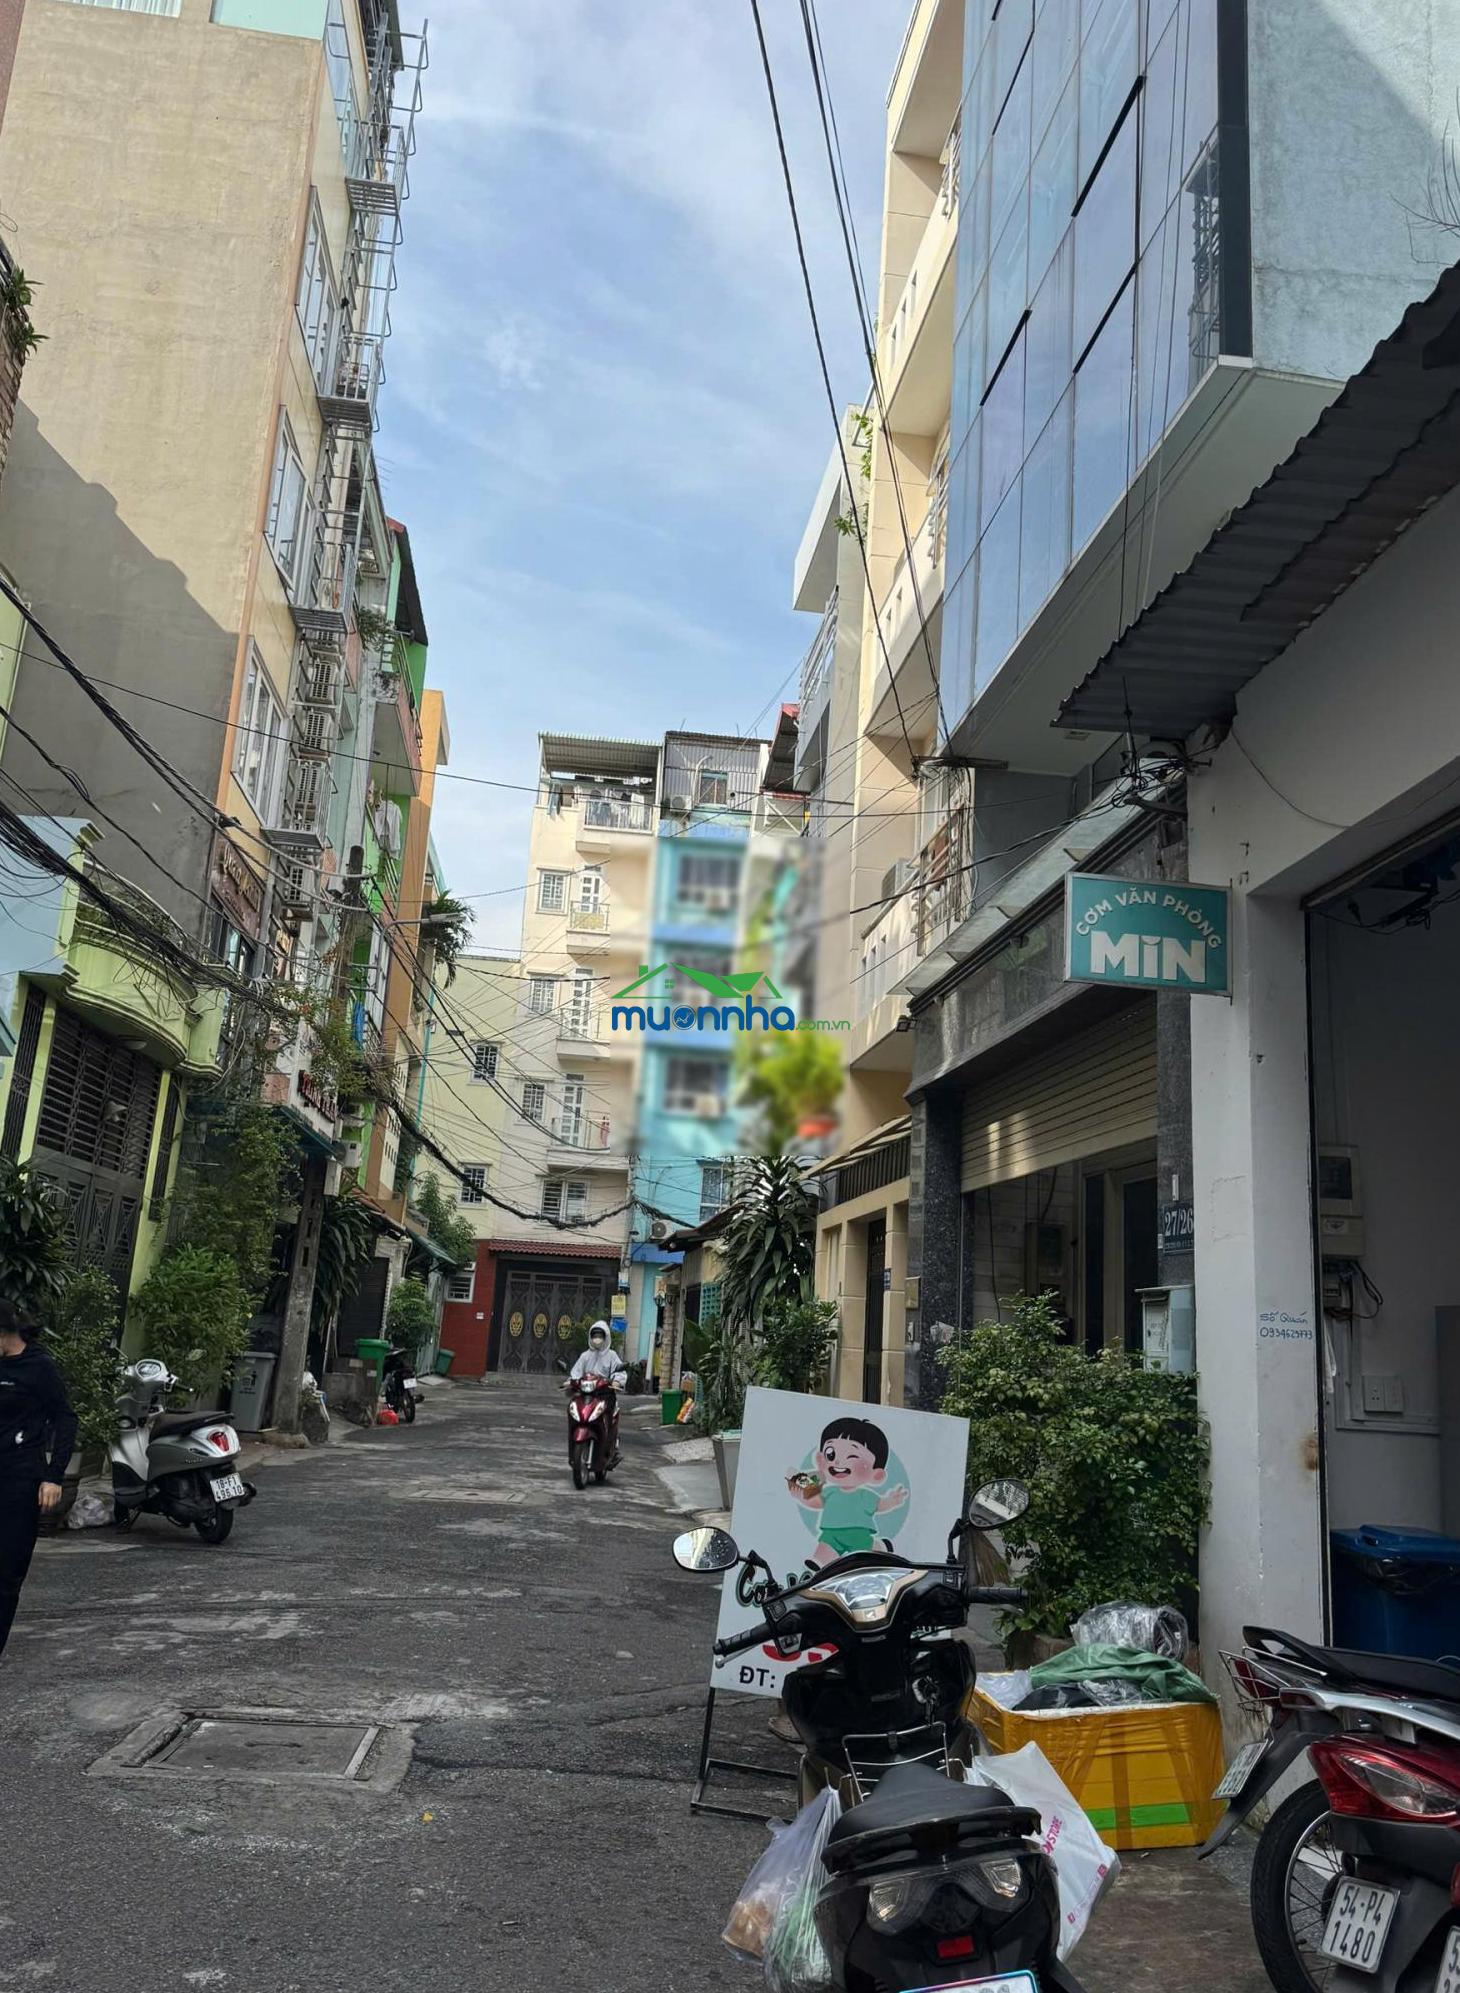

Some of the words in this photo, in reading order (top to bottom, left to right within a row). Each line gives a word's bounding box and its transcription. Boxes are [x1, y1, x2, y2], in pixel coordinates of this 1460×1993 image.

[1076, 899, 1113, 936] CƠM
[1115, 887, 1156, 906] VĂN
[1162, 894, 1222, 948] PHÒNG
[1164, 1208, 1194, 1236] 27/26
[739, 1665, 775, 1688] ĐT:
[1329, 1920, 1376, 1963] 1480
